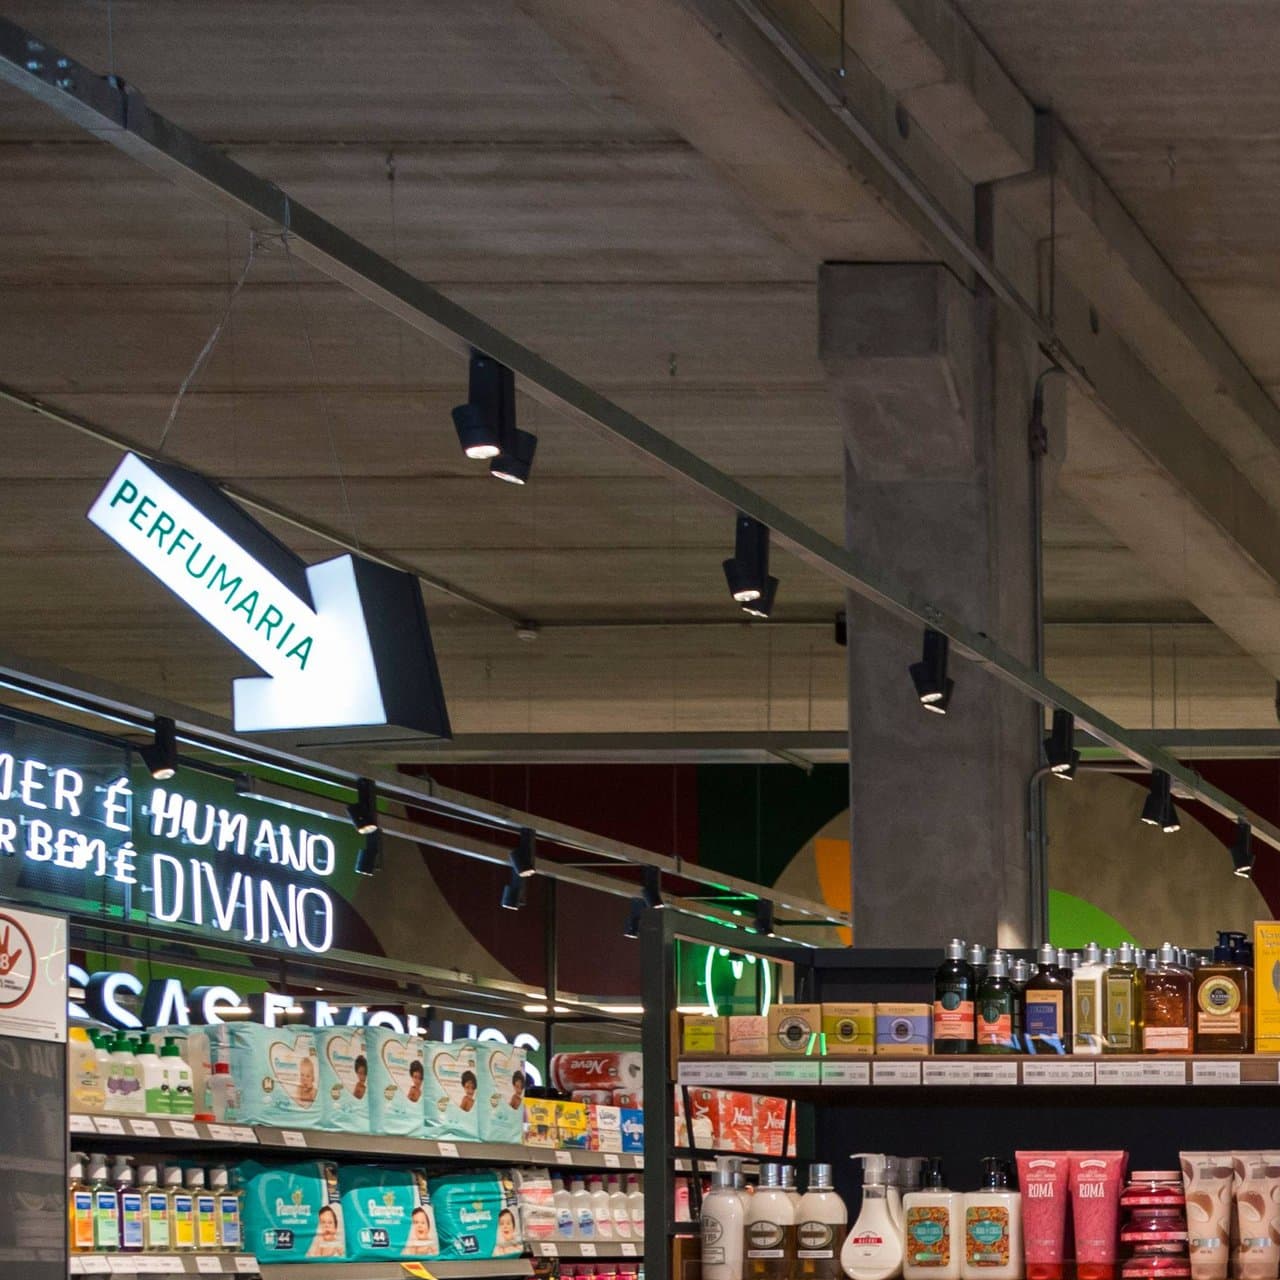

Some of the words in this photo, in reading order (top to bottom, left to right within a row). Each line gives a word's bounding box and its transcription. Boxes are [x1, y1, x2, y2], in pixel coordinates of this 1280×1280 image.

[109, 479, 315, 670] PERFUMARIA
[103, 777, 133, 832] É
[150, 787, 335, 876] HUMANO
[25, 819, 106, 876] BEM
[114, 841, 138, 884] É
[152, 853, 334, 953] DIVINO
[570, 1057, 609, 1074] Neve
[1028, 1181, 1054, 1198] ROMÃ
[1079, 1181, 1105, 1198] ROMÃ
